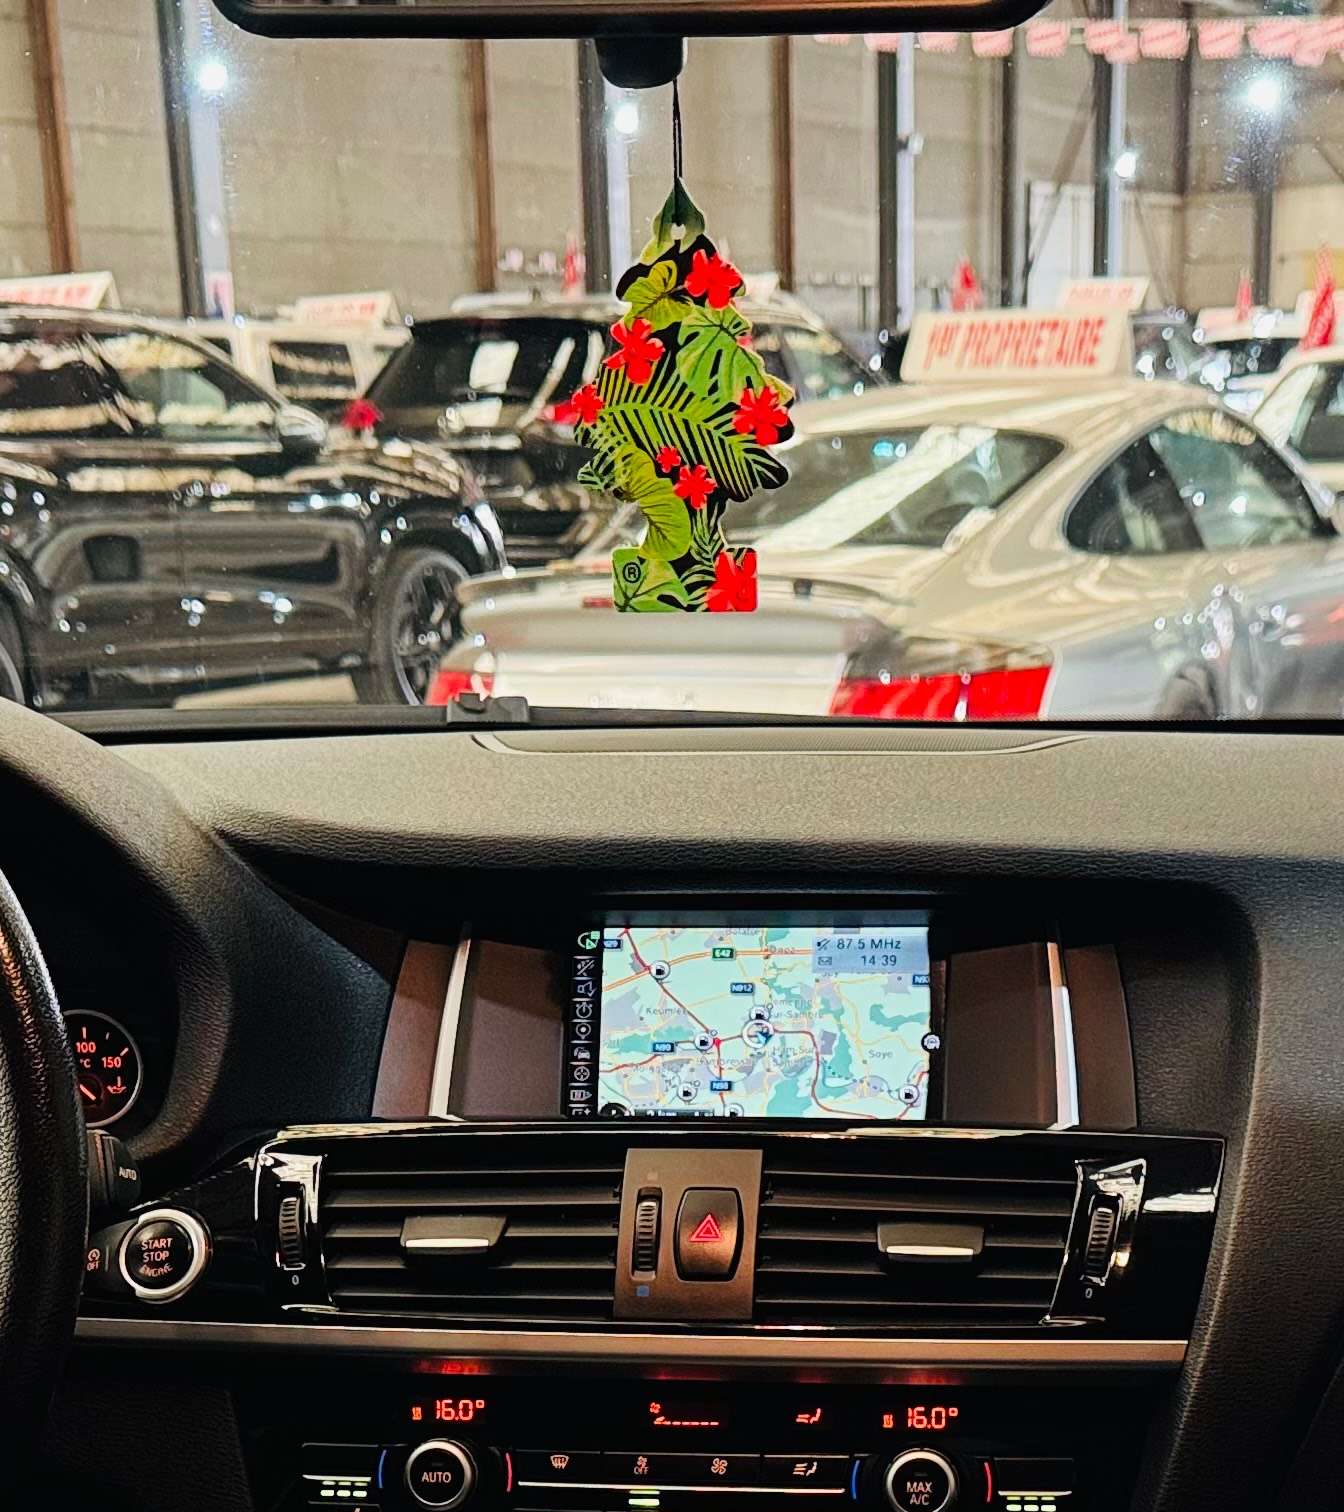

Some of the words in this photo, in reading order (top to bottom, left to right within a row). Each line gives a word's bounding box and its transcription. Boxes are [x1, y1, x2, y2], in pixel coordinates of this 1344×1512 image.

[870, 938, 902, 950] MHz
[76, 1042, 96, 1054] 100
[101, 1056, 122, 1069] 150
[118, 1166, 137, 1181] AUTO
[141, 1237, 173, 1250] START
[143, 1250, 170, 1262] STOP
[421, 1470, 452, 1484] AUTO
[906, 1480, 933, 1494] MAX
[909, 1493, 930, 1507] A/C
